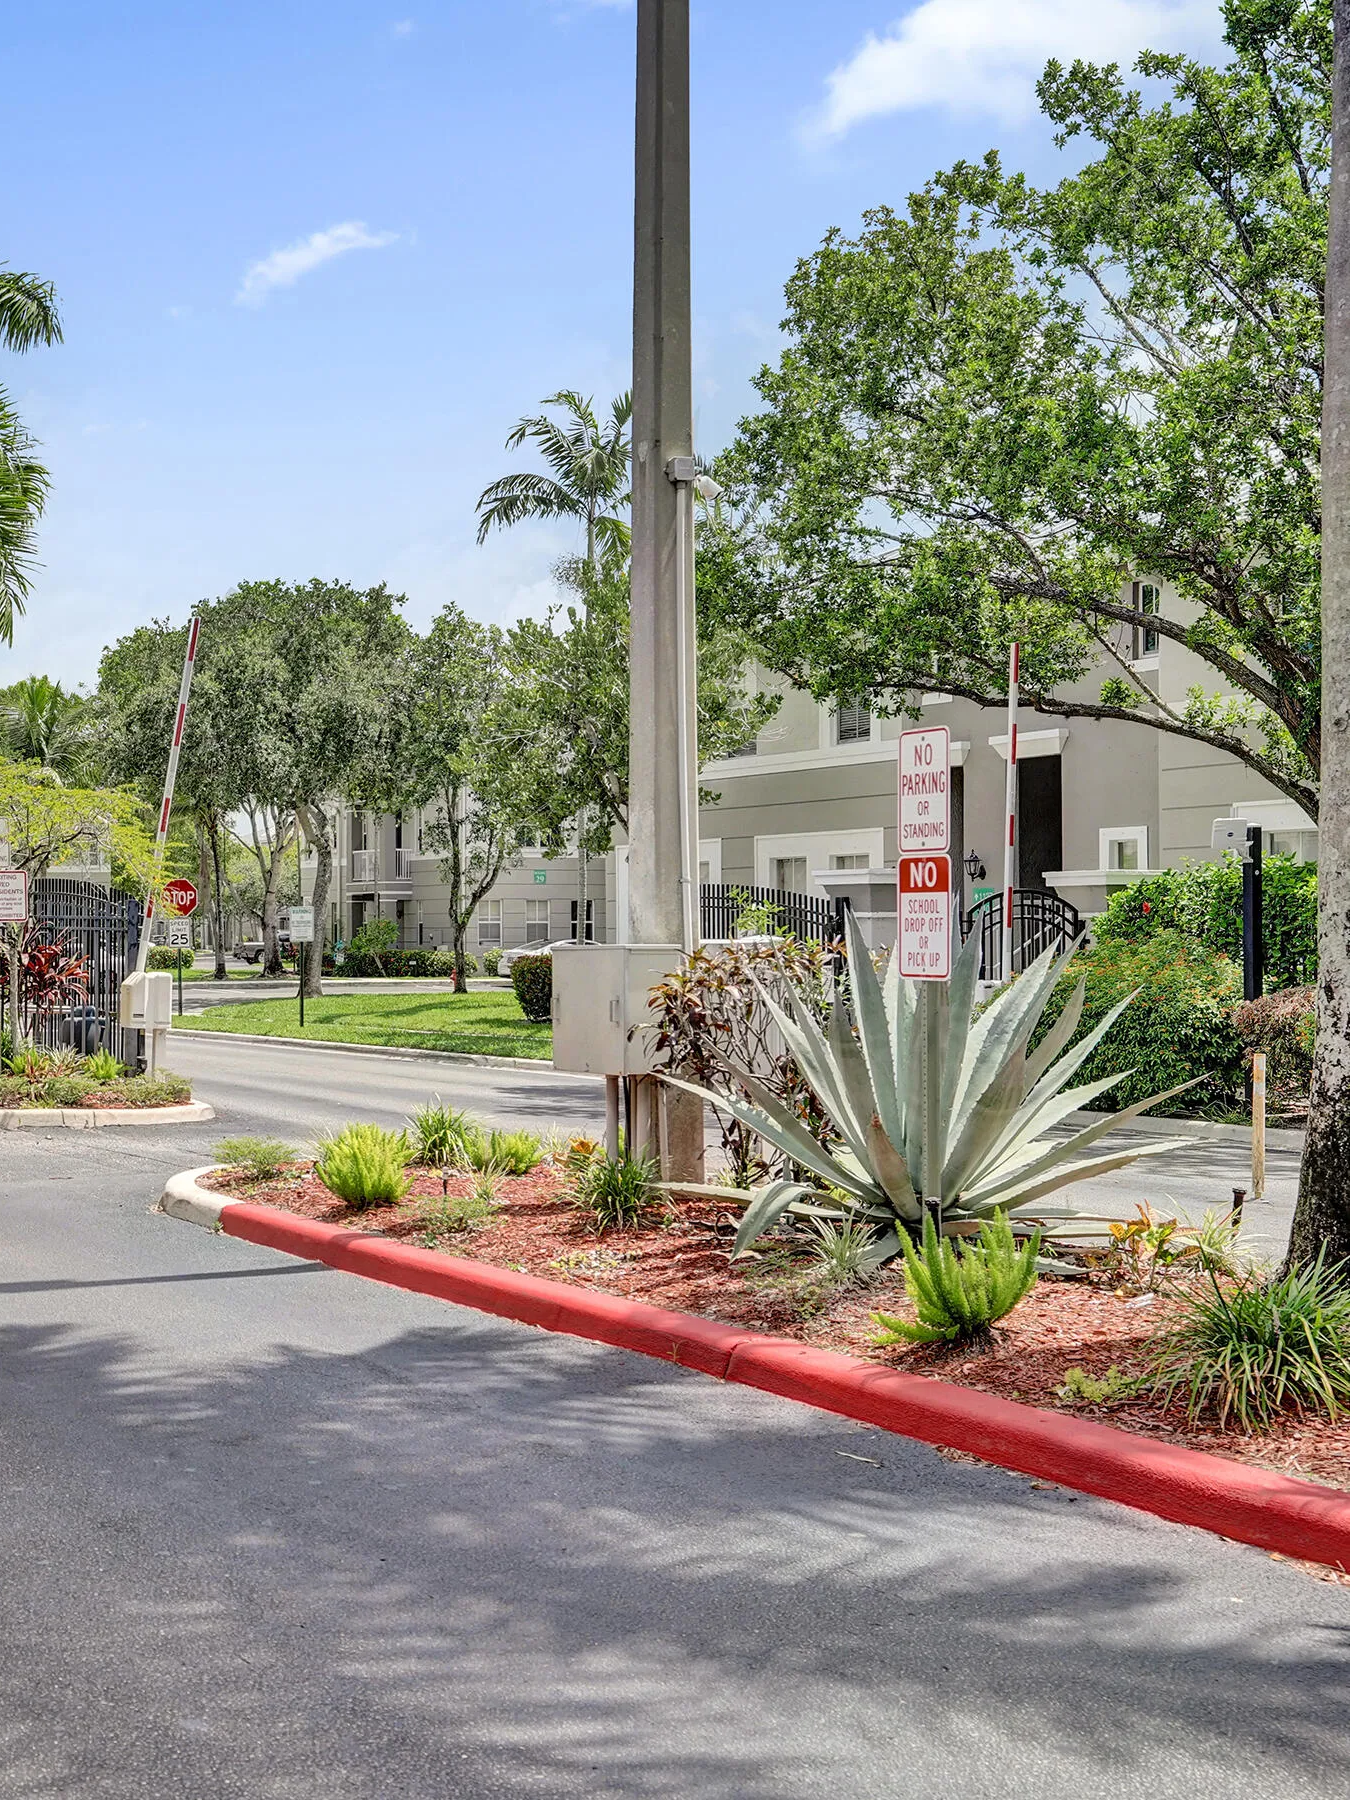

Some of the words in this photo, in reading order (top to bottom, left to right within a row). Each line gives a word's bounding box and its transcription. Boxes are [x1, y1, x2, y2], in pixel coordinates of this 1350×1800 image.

[914, 743, 933, 767] NO
[902, 770, 945, 796] PARKING
[917, 800, 930, 816] OR
[903, 821, 945, 839] STANDING
[535, 875, 545, 883] 29
[910, 861, 938, 888] NO
[163, 891, 195, 906] STOP
[908, 899, 940, 914] SCHOOL
[904, 918, 926, 932] DROP
[928, 917, 944, 932] OFF
[171, 934, 189, 945] 25
[918, 935, 929, 949] OR
[907, 952, 926, 967] PICK
[929, 952, 941, 968] UP
